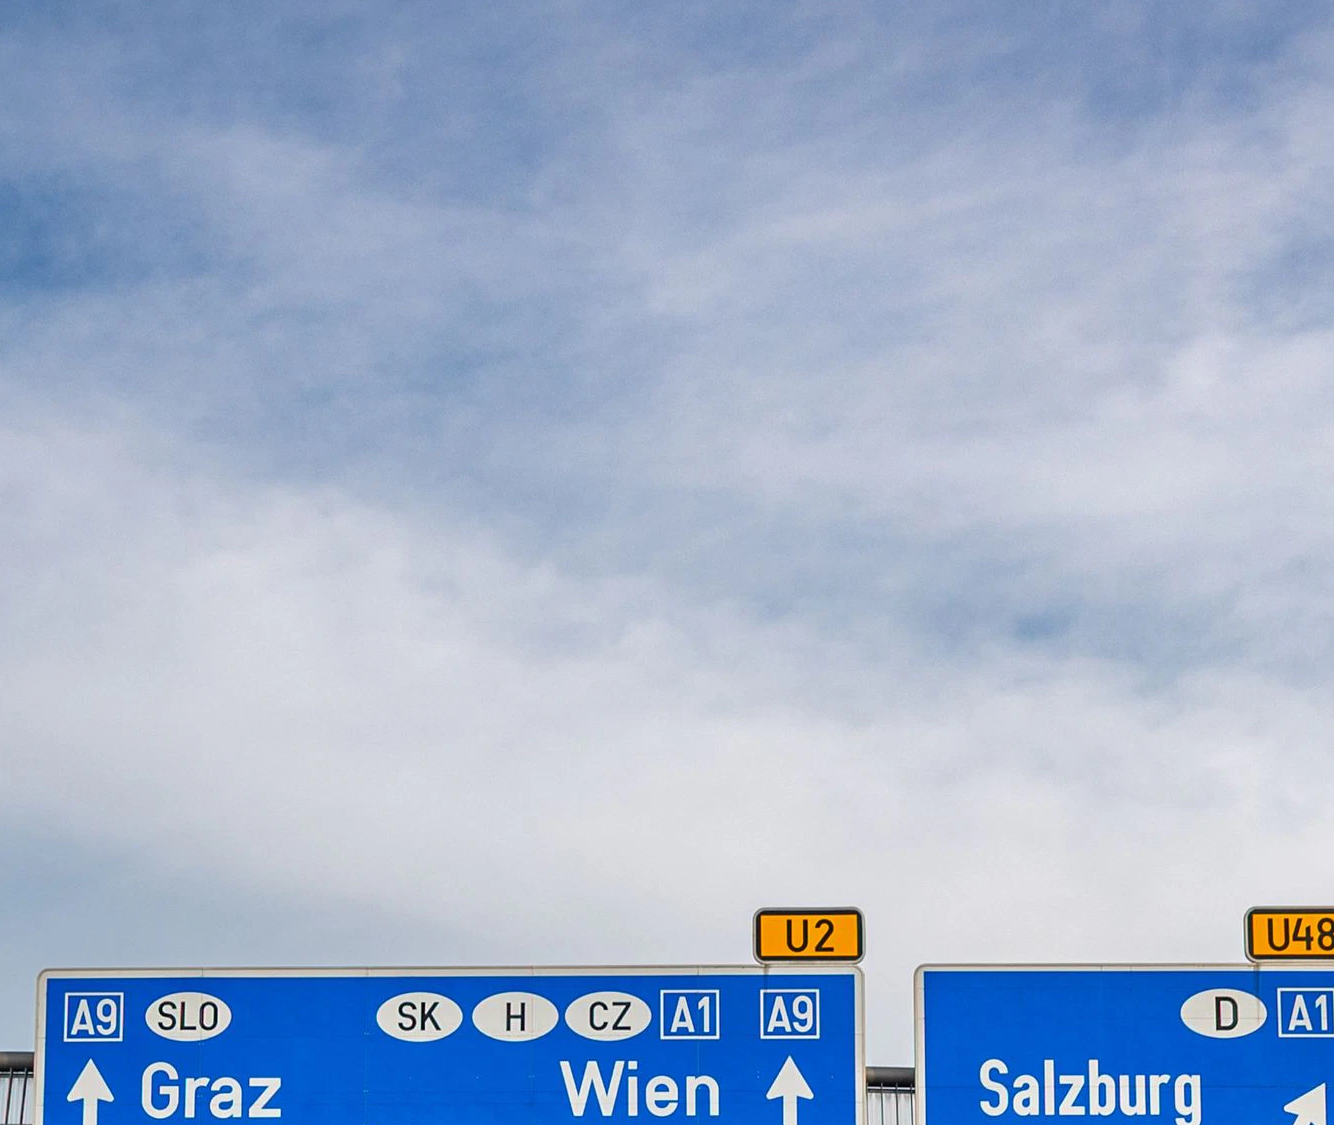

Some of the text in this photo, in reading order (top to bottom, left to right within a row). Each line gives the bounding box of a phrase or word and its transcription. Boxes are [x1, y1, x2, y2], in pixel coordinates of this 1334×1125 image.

[786, 918, 834, 952] U2
[70, 998, 117, 1036] A9
[157, 1001, 219, 1031] SLO
[398, 1001, 442, 1031] SK
[505, 1002, 526, 1032] H
[589, 1001, 632, 1031] CZ
[670, 996, 710, 1033] A1
[767, 996, 814, 1033] A9
[1215, 996, 1239, 1031] D
[1288, 996, 1330, 1032] A1
[141, 1061, 282, 1119] Graz
[559, 1060, 720, 1117] Wien
